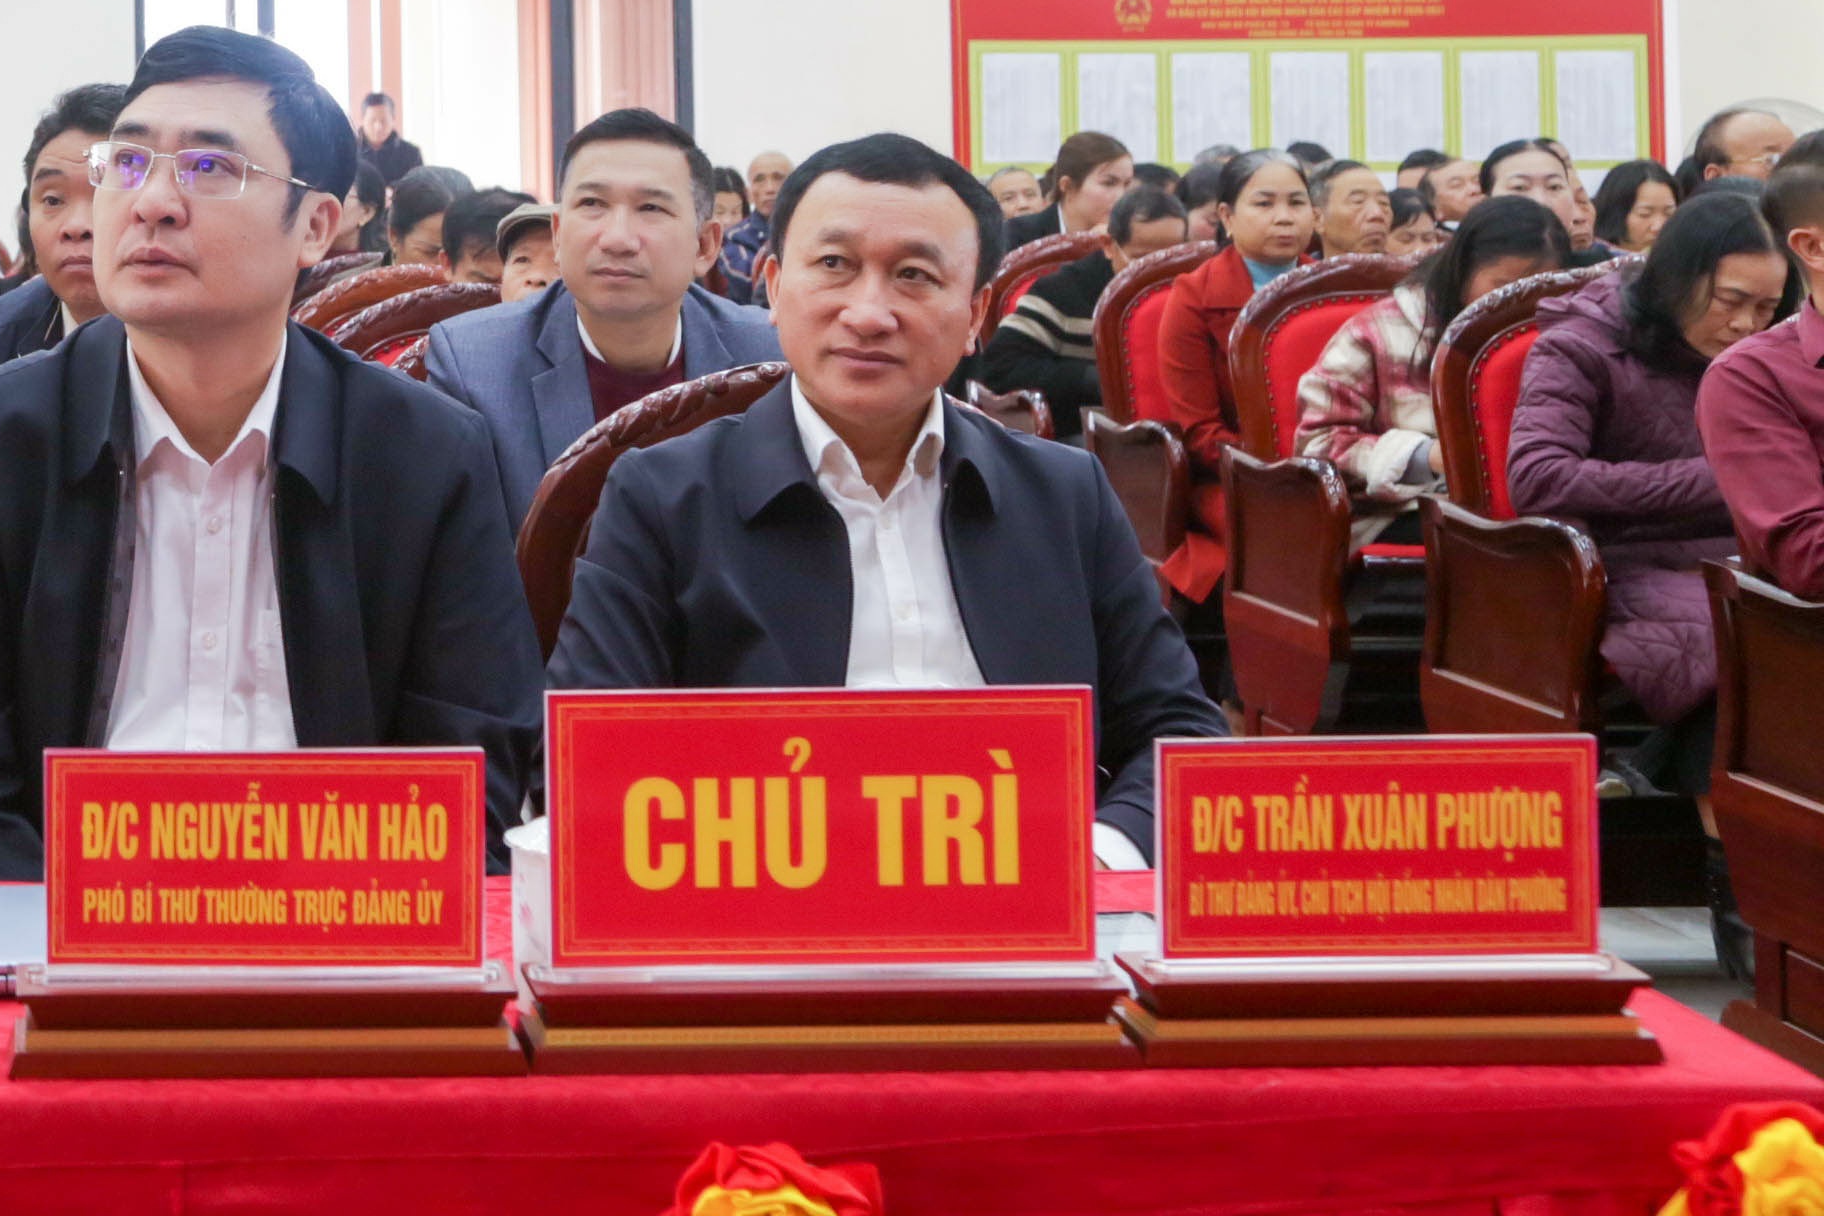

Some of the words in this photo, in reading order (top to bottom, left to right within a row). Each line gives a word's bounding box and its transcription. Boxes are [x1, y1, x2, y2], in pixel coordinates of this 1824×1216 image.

[81, 802, 139, 860] Đ/C
[150, 782, 288, 861] NGUYỄN
[299, 791, 368, 861] VĂN
[379, 784, 448, 861] HẢO
[623, 737, 828, 890] CHỦ
[861, 749, 1020, 886] TRÌ
[1191, 795, 1244, 853] Đ/C
[1252, 774, 1333, 852] TRẦN
[1342, 781, 1428, 851] XUÂN
[1437, 786, 1563, 862] PHƯỢNG
[83, 882, 125, 923] PHÓ
[131, 881, 152, 923] BÍ
[159, 888, 200, 923] THƯ
[205, 881, 287, 924] THƯỜNG
[293, 888, 347, 932] TRỰC
[352, 879, 411, 924] ĐẢNG
[417, 879, 444, 924] ỦY
